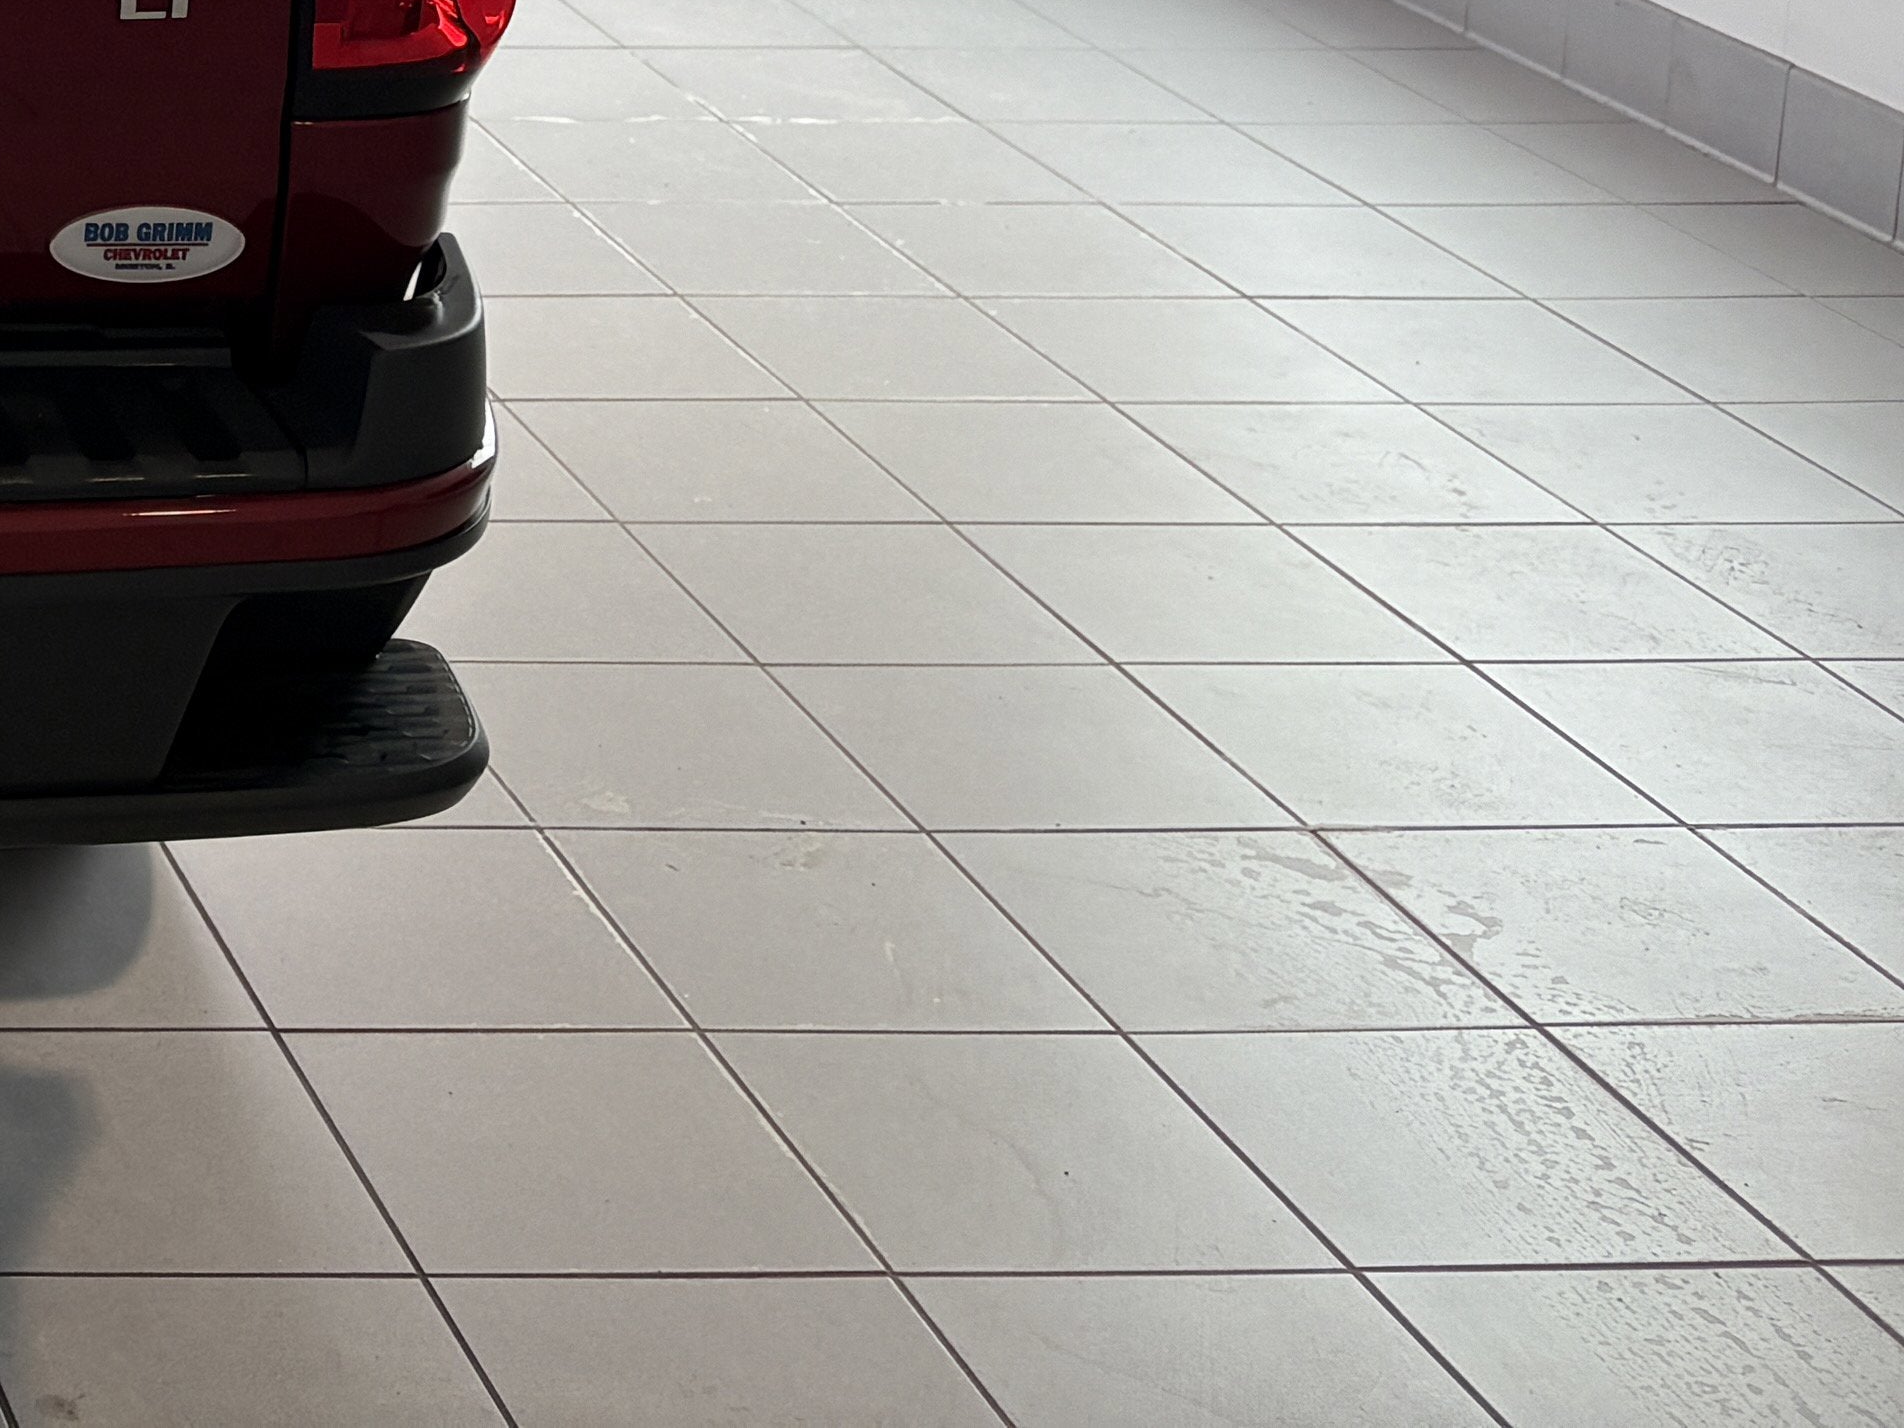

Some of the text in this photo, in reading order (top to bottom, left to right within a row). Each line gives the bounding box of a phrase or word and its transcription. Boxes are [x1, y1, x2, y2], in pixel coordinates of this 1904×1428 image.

[83, 221, 214, 243] BOB GRIMM
[103, 247, 191, 262] CHEVROLET
